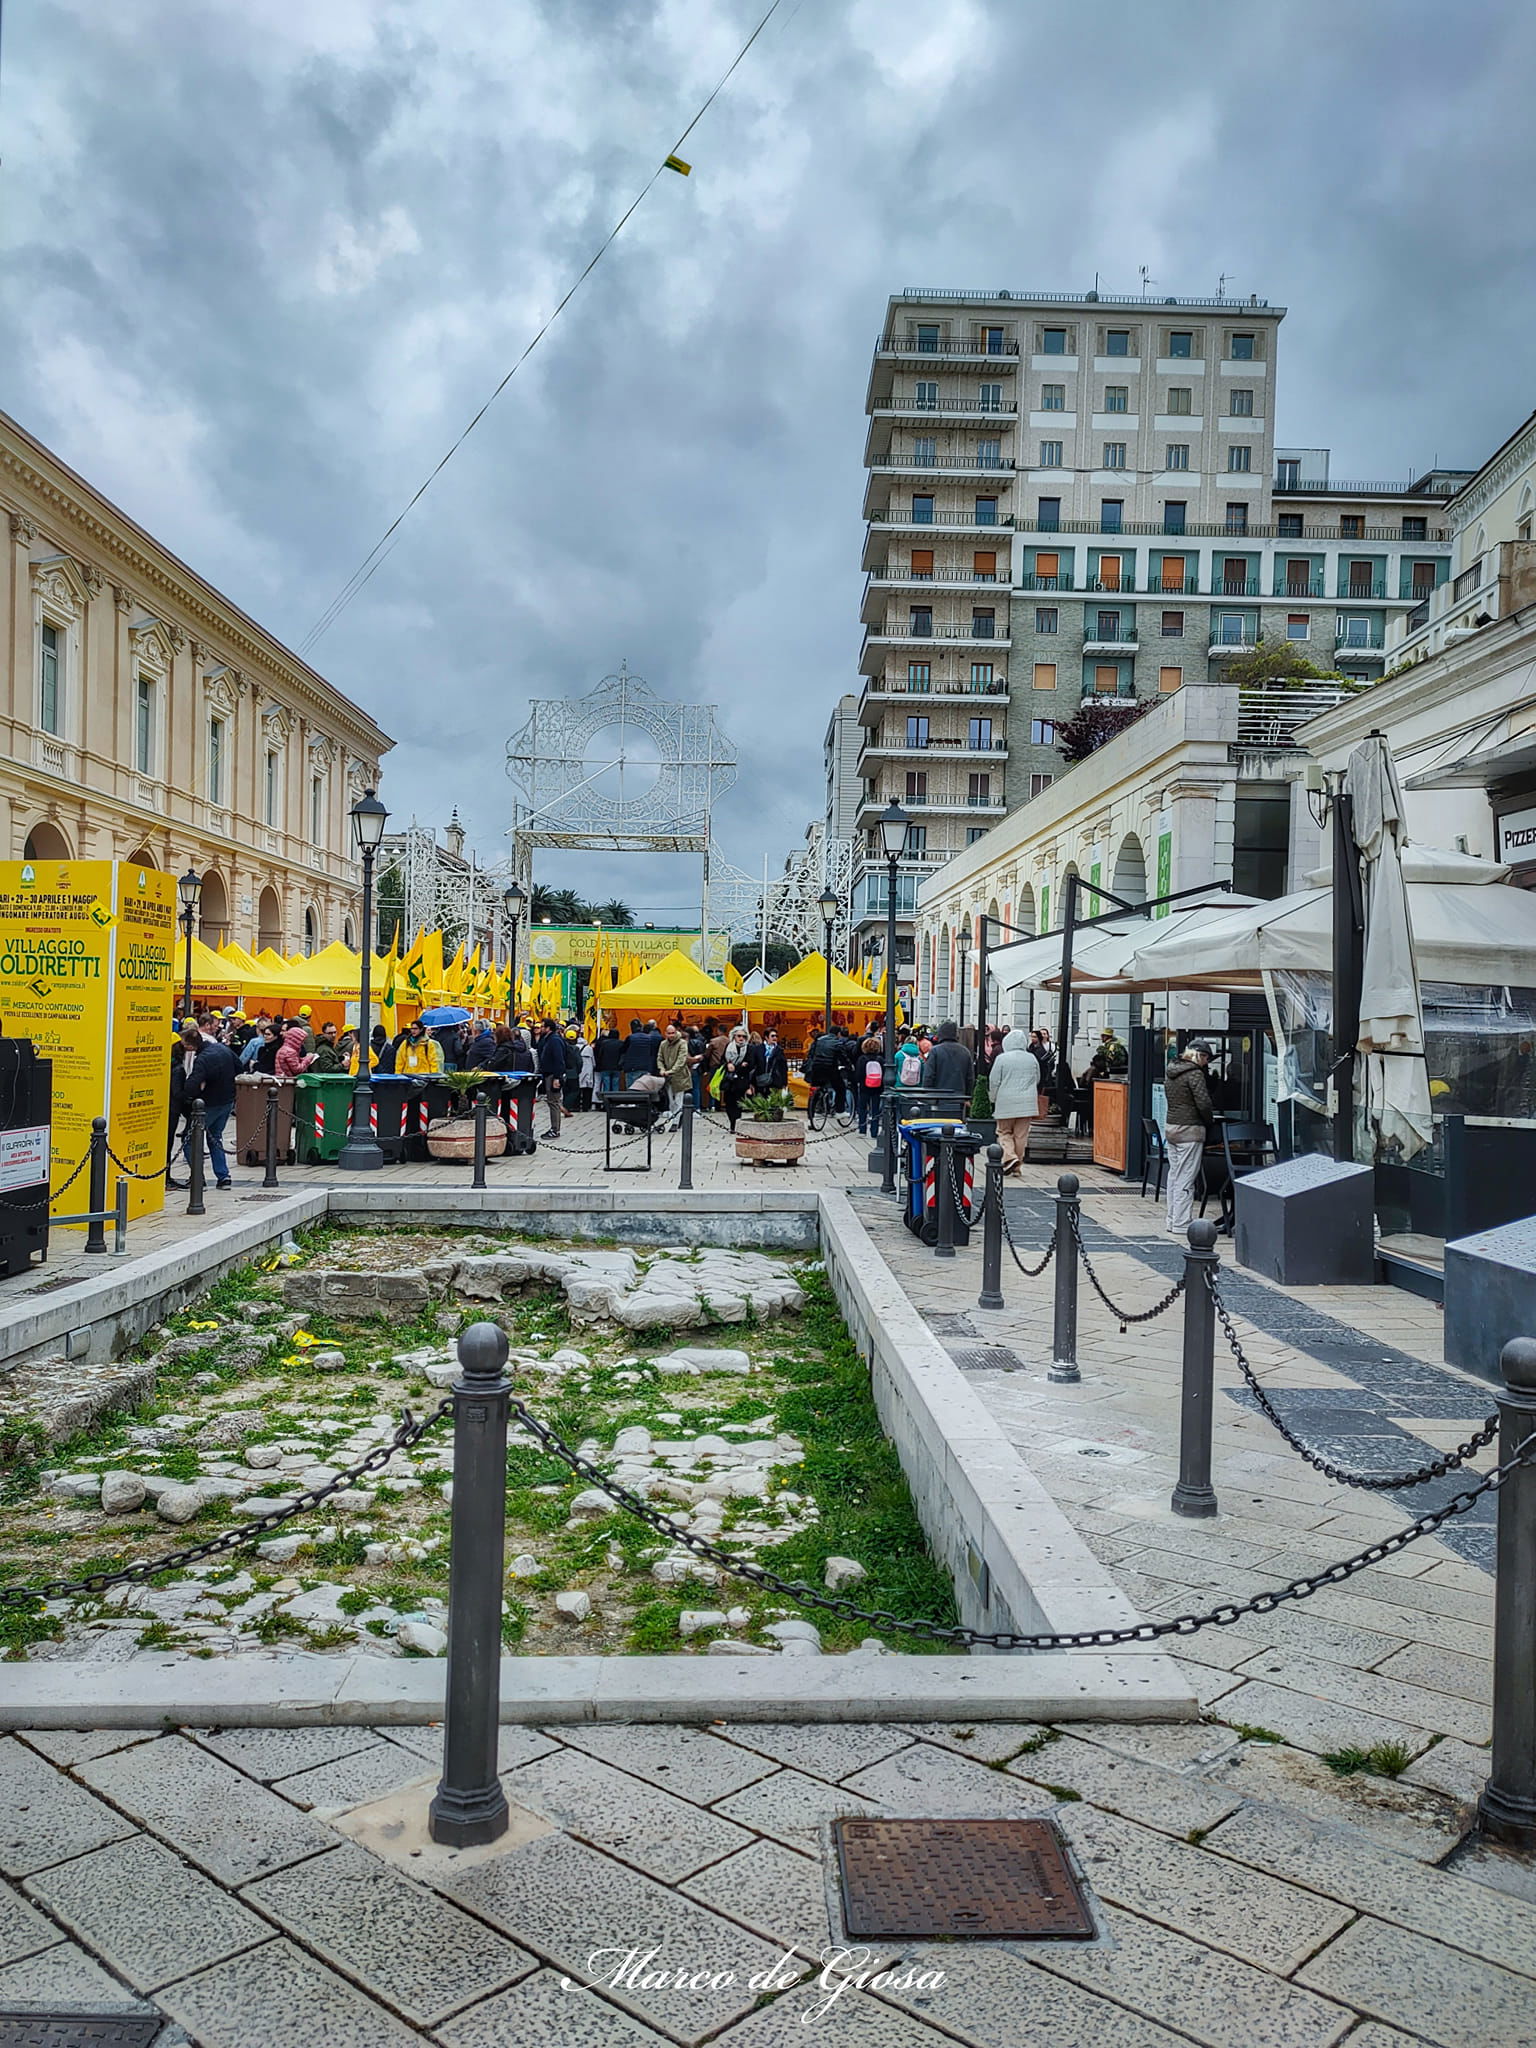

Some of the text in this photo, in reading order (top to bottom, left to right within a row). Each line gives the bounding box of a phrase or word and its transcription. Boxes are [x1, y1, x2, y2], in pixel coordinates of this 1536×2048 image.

[39, 895, 61, 904] APRILE
[31, 911, 67, 920] IMPERATORE
[70, 911, 90, 920] AUGUS
[5, 938, 85, 955] VILLAGGIO
[569, 938, 630, 949] COLDRETTI
[633, 939, 679, 950] VILLAGE
[129, 943, 167, 960] VILLAGGIO
[0, 954, 100, 977] OLDIRETTI
[119, 958, 171, 981] COLDIRETTI
[12, 1001, 84, 1012] MERCATO CONTADINO
[685, 997, 733, 1005] COLDIRETTI
